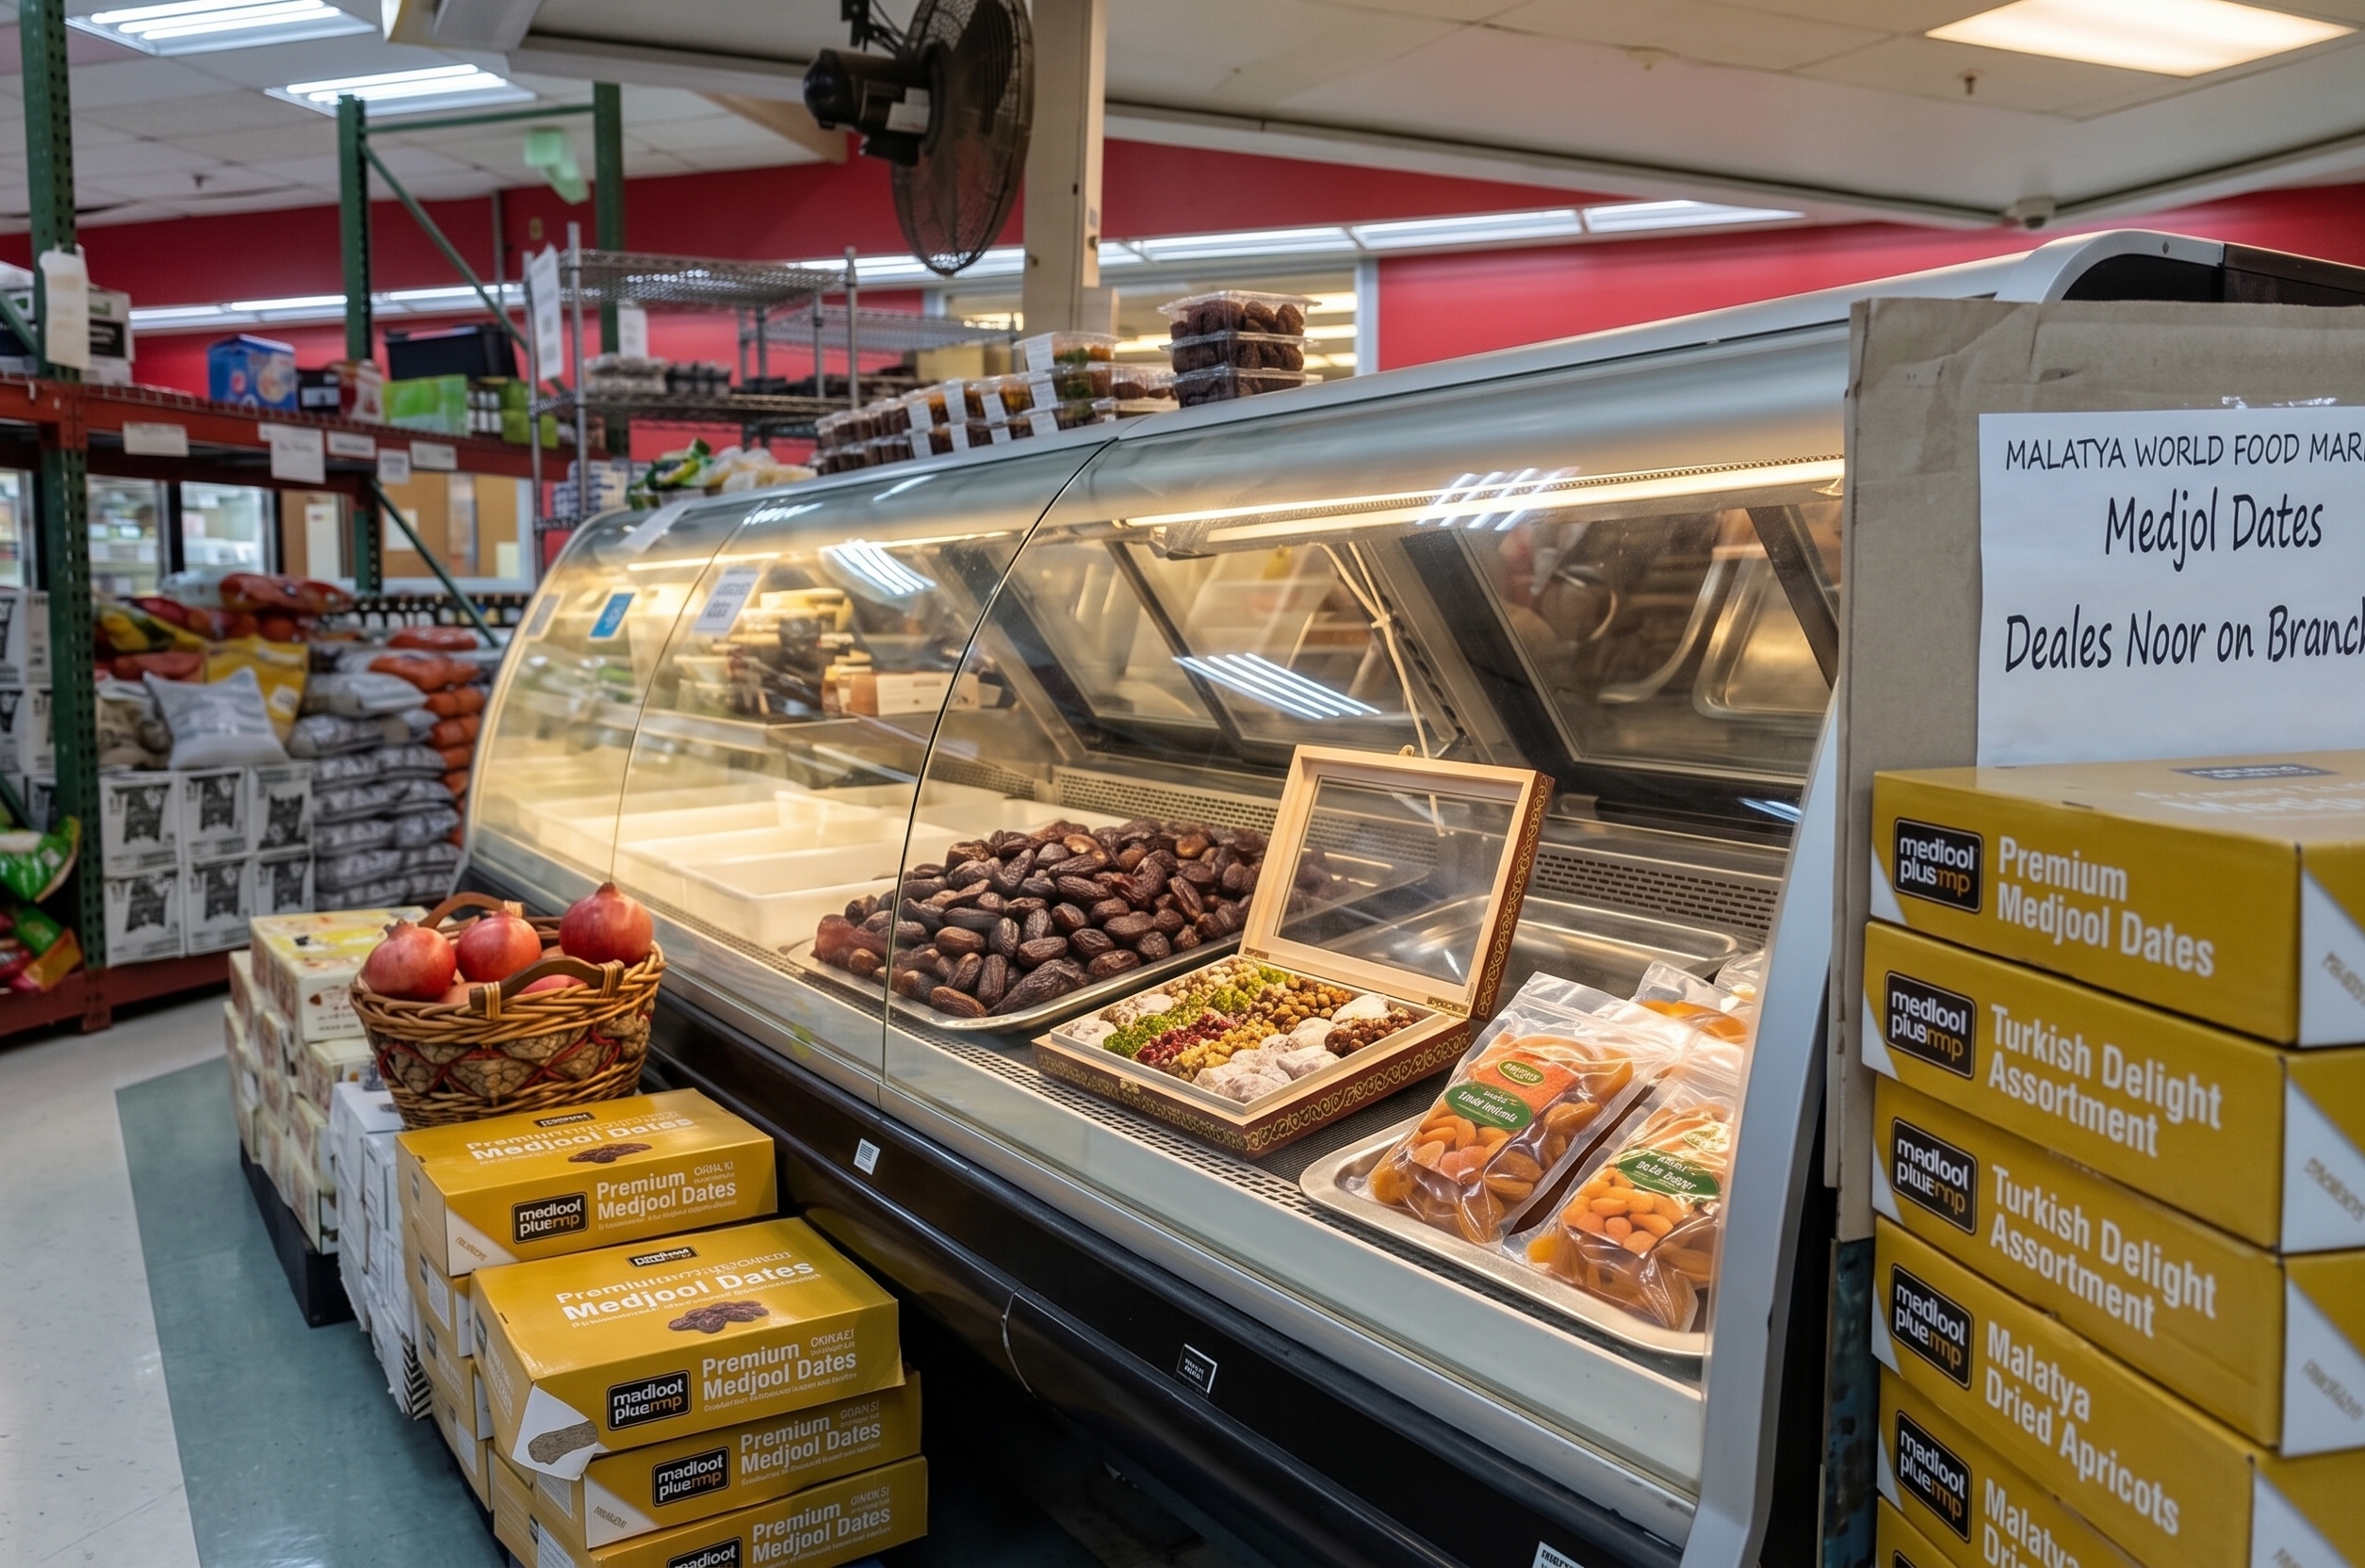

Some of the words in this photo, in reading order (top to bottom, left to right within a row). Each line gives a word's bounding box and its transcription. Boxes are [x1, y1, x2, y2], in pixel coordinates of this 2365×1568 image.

[2006, 437, 2127, 470] MALATYA
[2134, 434, 2224, 467] WORLD
[2234, 433, 2299, 466] FOOD
[2309, 432, 2365, 463] MAR
[2105, 486, 2217, 572] Medjol
[2233, 493, 2324, 550] Dates
[2005, 603, 2112, 673] Deales
[2127, 610, 2206, 668] Noor
[2217, 622, 2254, 662] on
[1998, 835, 2128, 902] Premium
[1998, 881, 2110, 949] Medjool
[2120, 909, 2215, 977] Dates
[1990, 1004, 2092, 1079] Turkish
[2102, 1044, 2222, 1130] Delight
[1988, 1052, 2159, 1159] Assortment
[596, 1171, 685, 1200] Premium
[597, 1185, 677, 1220] Medjool
[682, 1182, 736, 1204] Dates
[1992, 1165, 2090, 1252] Turkish
[2100, 1219, 2216, 1318] Delight
[562, 1280, 710, 1320] Medjool
[716, 1262, 815, 1290] Dates
[1990, 1213, 2155, 1338] Assortment
[702, 1343, 800, 1379] Premium
[704, 1368, 790, 1400] Medjool
[797, 1352, 856, 1380] Dates
[1986, 1320, 2091, 1422] Malatya
[741, 1416, 830, 1453] Premium
[741, 1436, 819, 1475] Medjool
[826, 1423, 881, 1450] Dates
[1984, 1365, 2052, 1446] Dried
[2060, 1423, 2180, 1536] Apricots
[753, 1503, 840, 1543] Premium
[753, 1523, 829, 1564] Medjool
[838, 1509, 890, 1537] Dates
